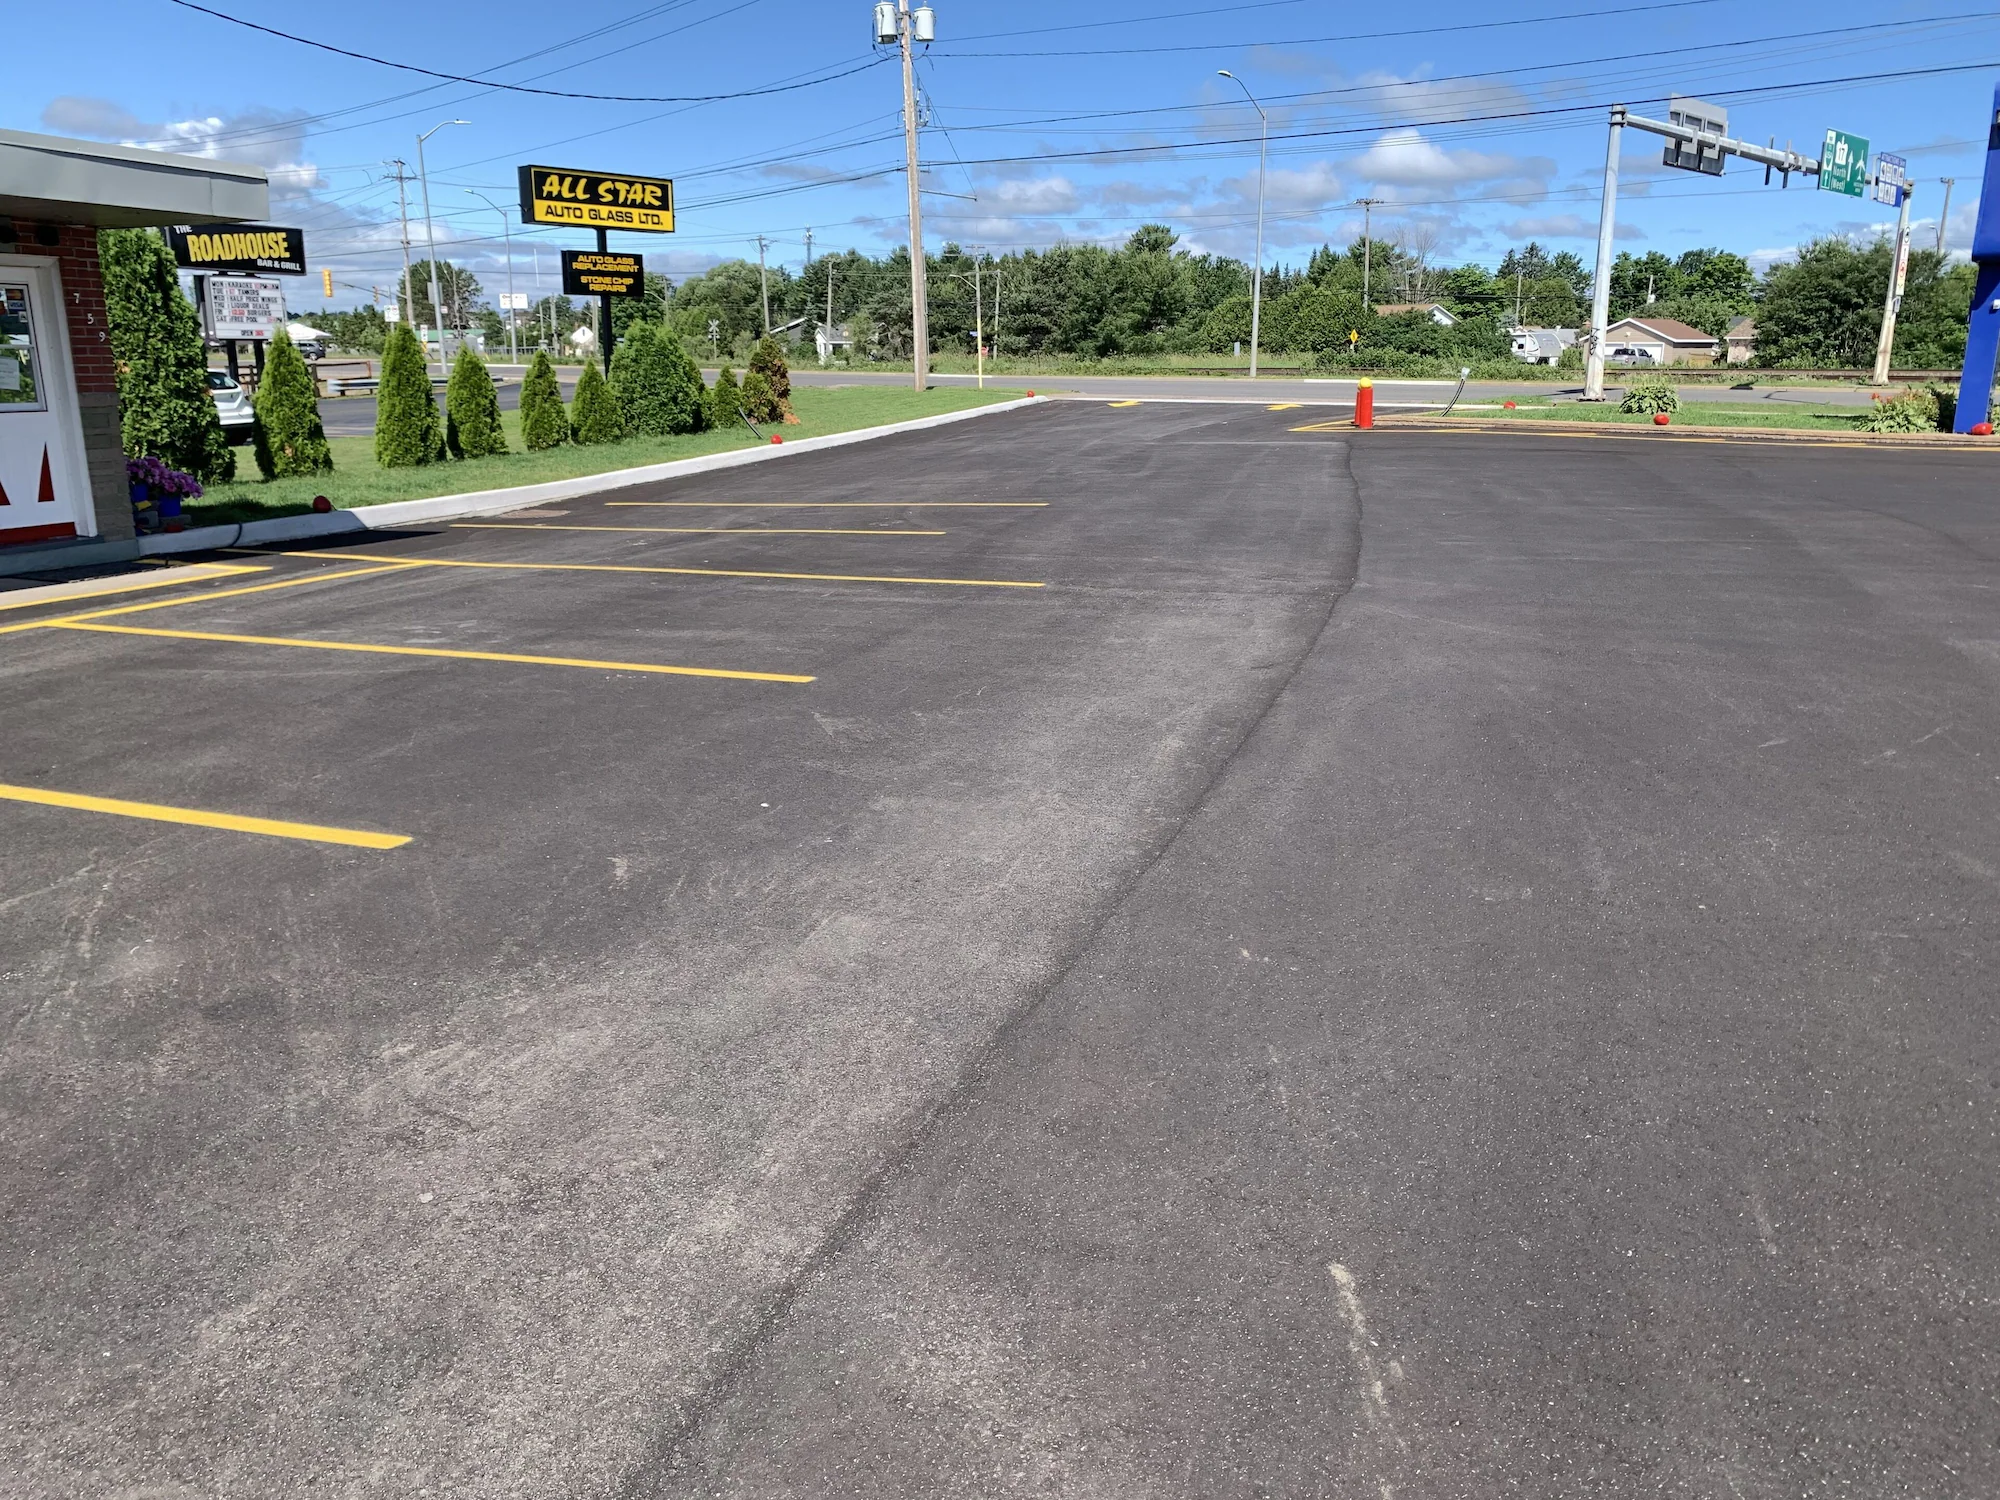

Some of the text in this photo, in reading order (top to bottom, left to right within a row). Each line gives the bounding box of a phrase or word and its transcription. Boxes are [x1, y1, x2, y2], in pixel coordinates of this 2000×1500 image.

[1833, 165, 1847, 178] North
[542, 174, 662, 206] ALL STAR
[545, 204, 663, 226] AUTO GLASS LTD.
[173, 225, 193, 234] THE
[186, 232, 290, 262] ROADHOUSE
[257, 259, 301, 271] BAR & GRILL
[577, 255, 634, 265] AUTO GLASS
[572, 262, 639, 272] REPLACEMENT
[580, 275, 634, 285] STONE CHIP
[589, 284, 627, 292] REPAIRS
